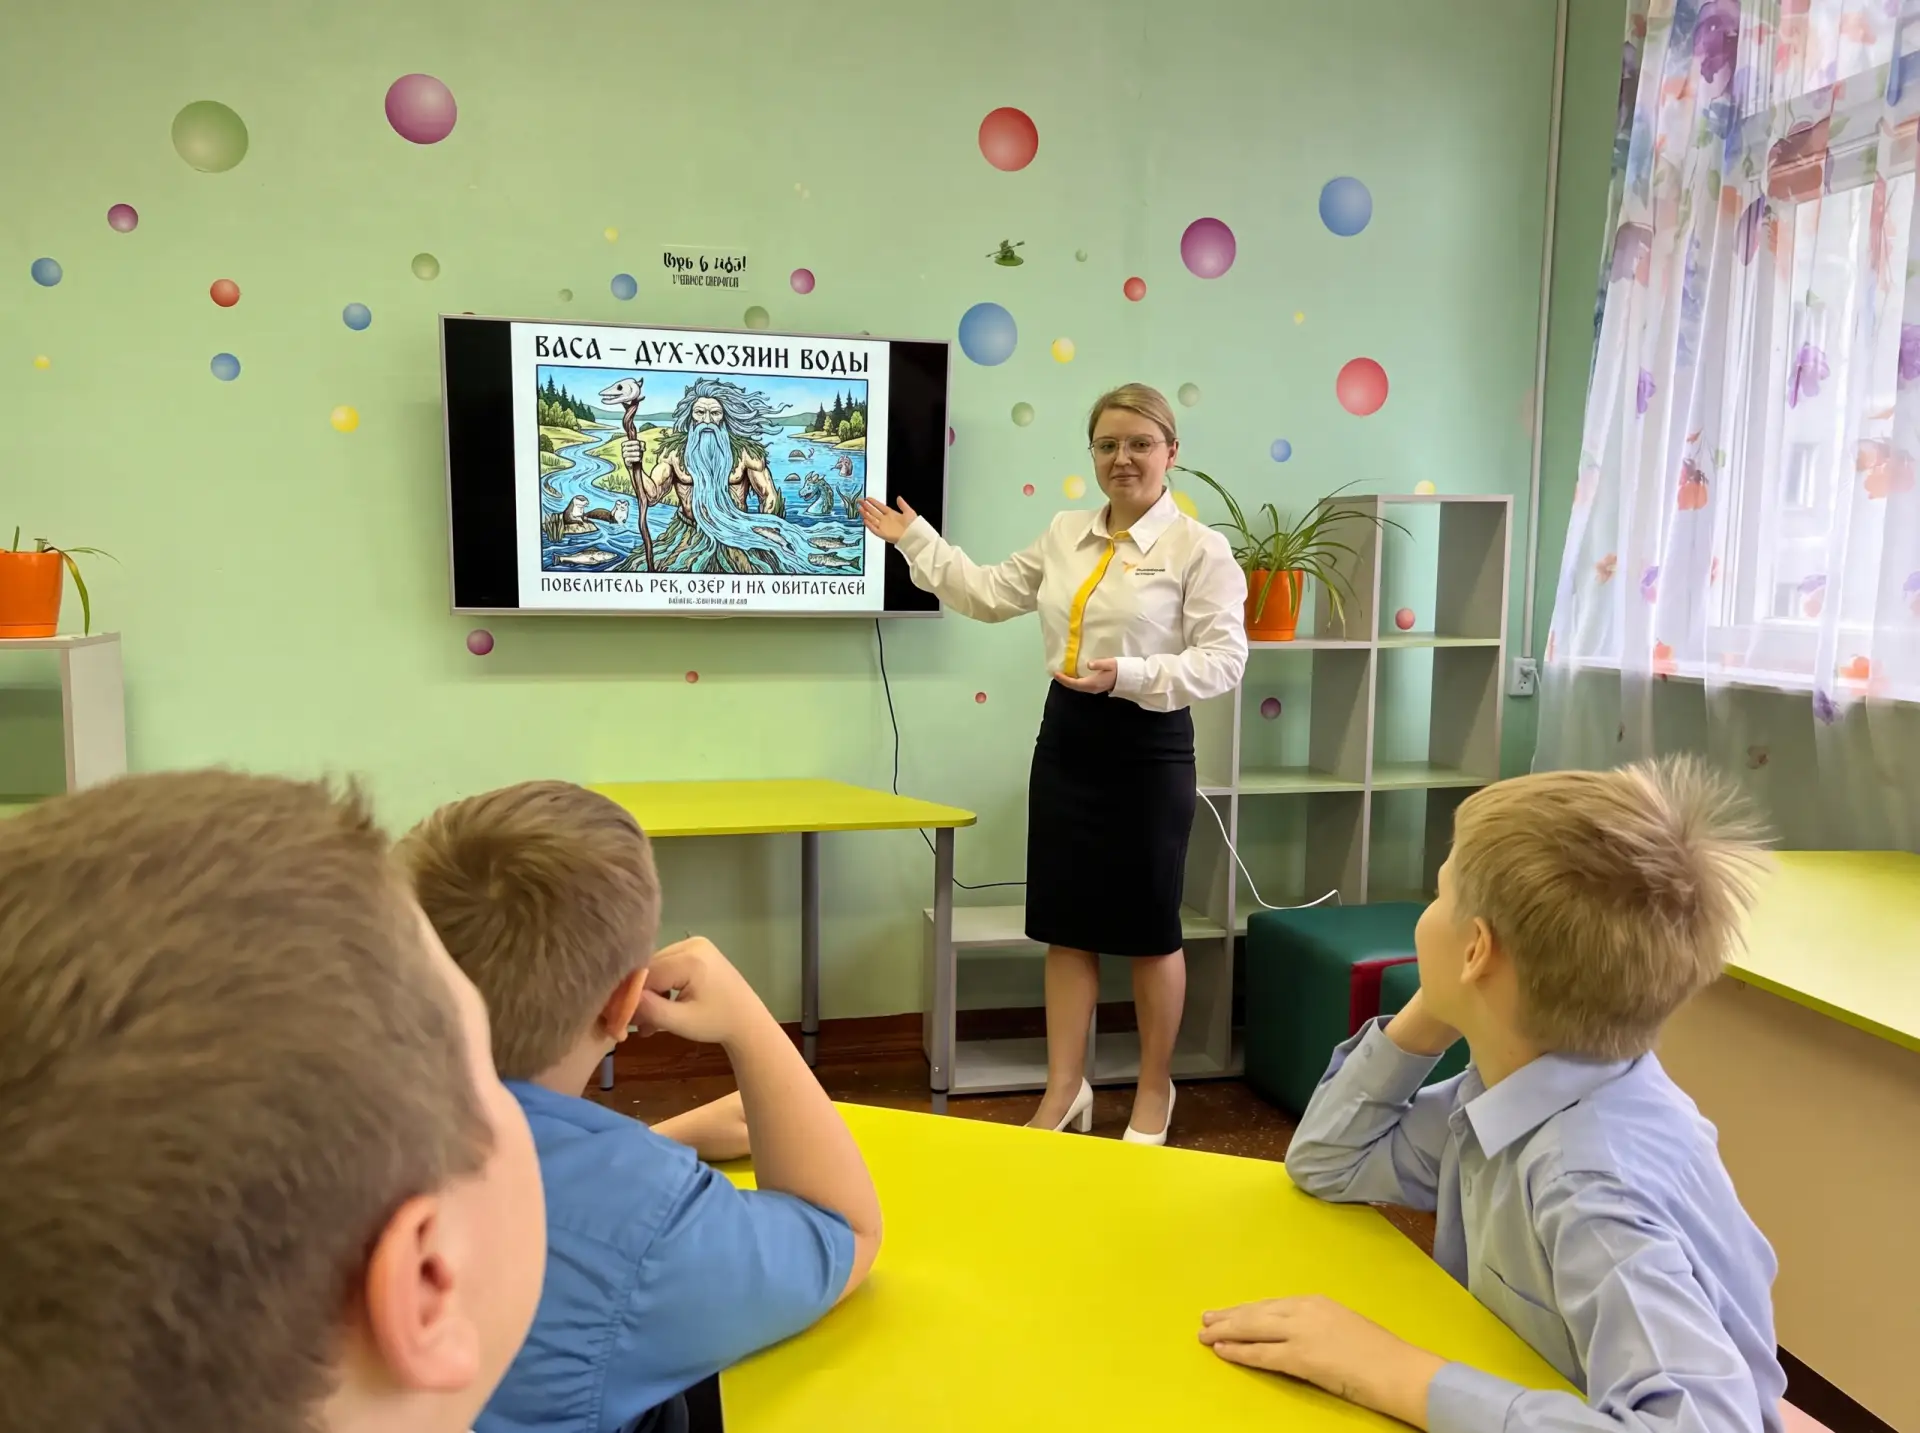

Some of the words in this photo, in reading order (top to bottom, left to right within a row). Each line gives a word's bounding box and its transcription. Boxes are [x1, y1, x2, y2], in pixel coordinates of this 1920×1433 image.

[535, 335, 602, 360] ВАСА
[634, 340, 789, 369] ДУХ-ХОЗЯИН
[800, 349, 868, 375] ВОДЫ
[541, 577, 644, 593] ПОВЕЛИТЕЛЬ
[650, 579, 682, 595] РЕК,
[731, 580, 741, 594] И
